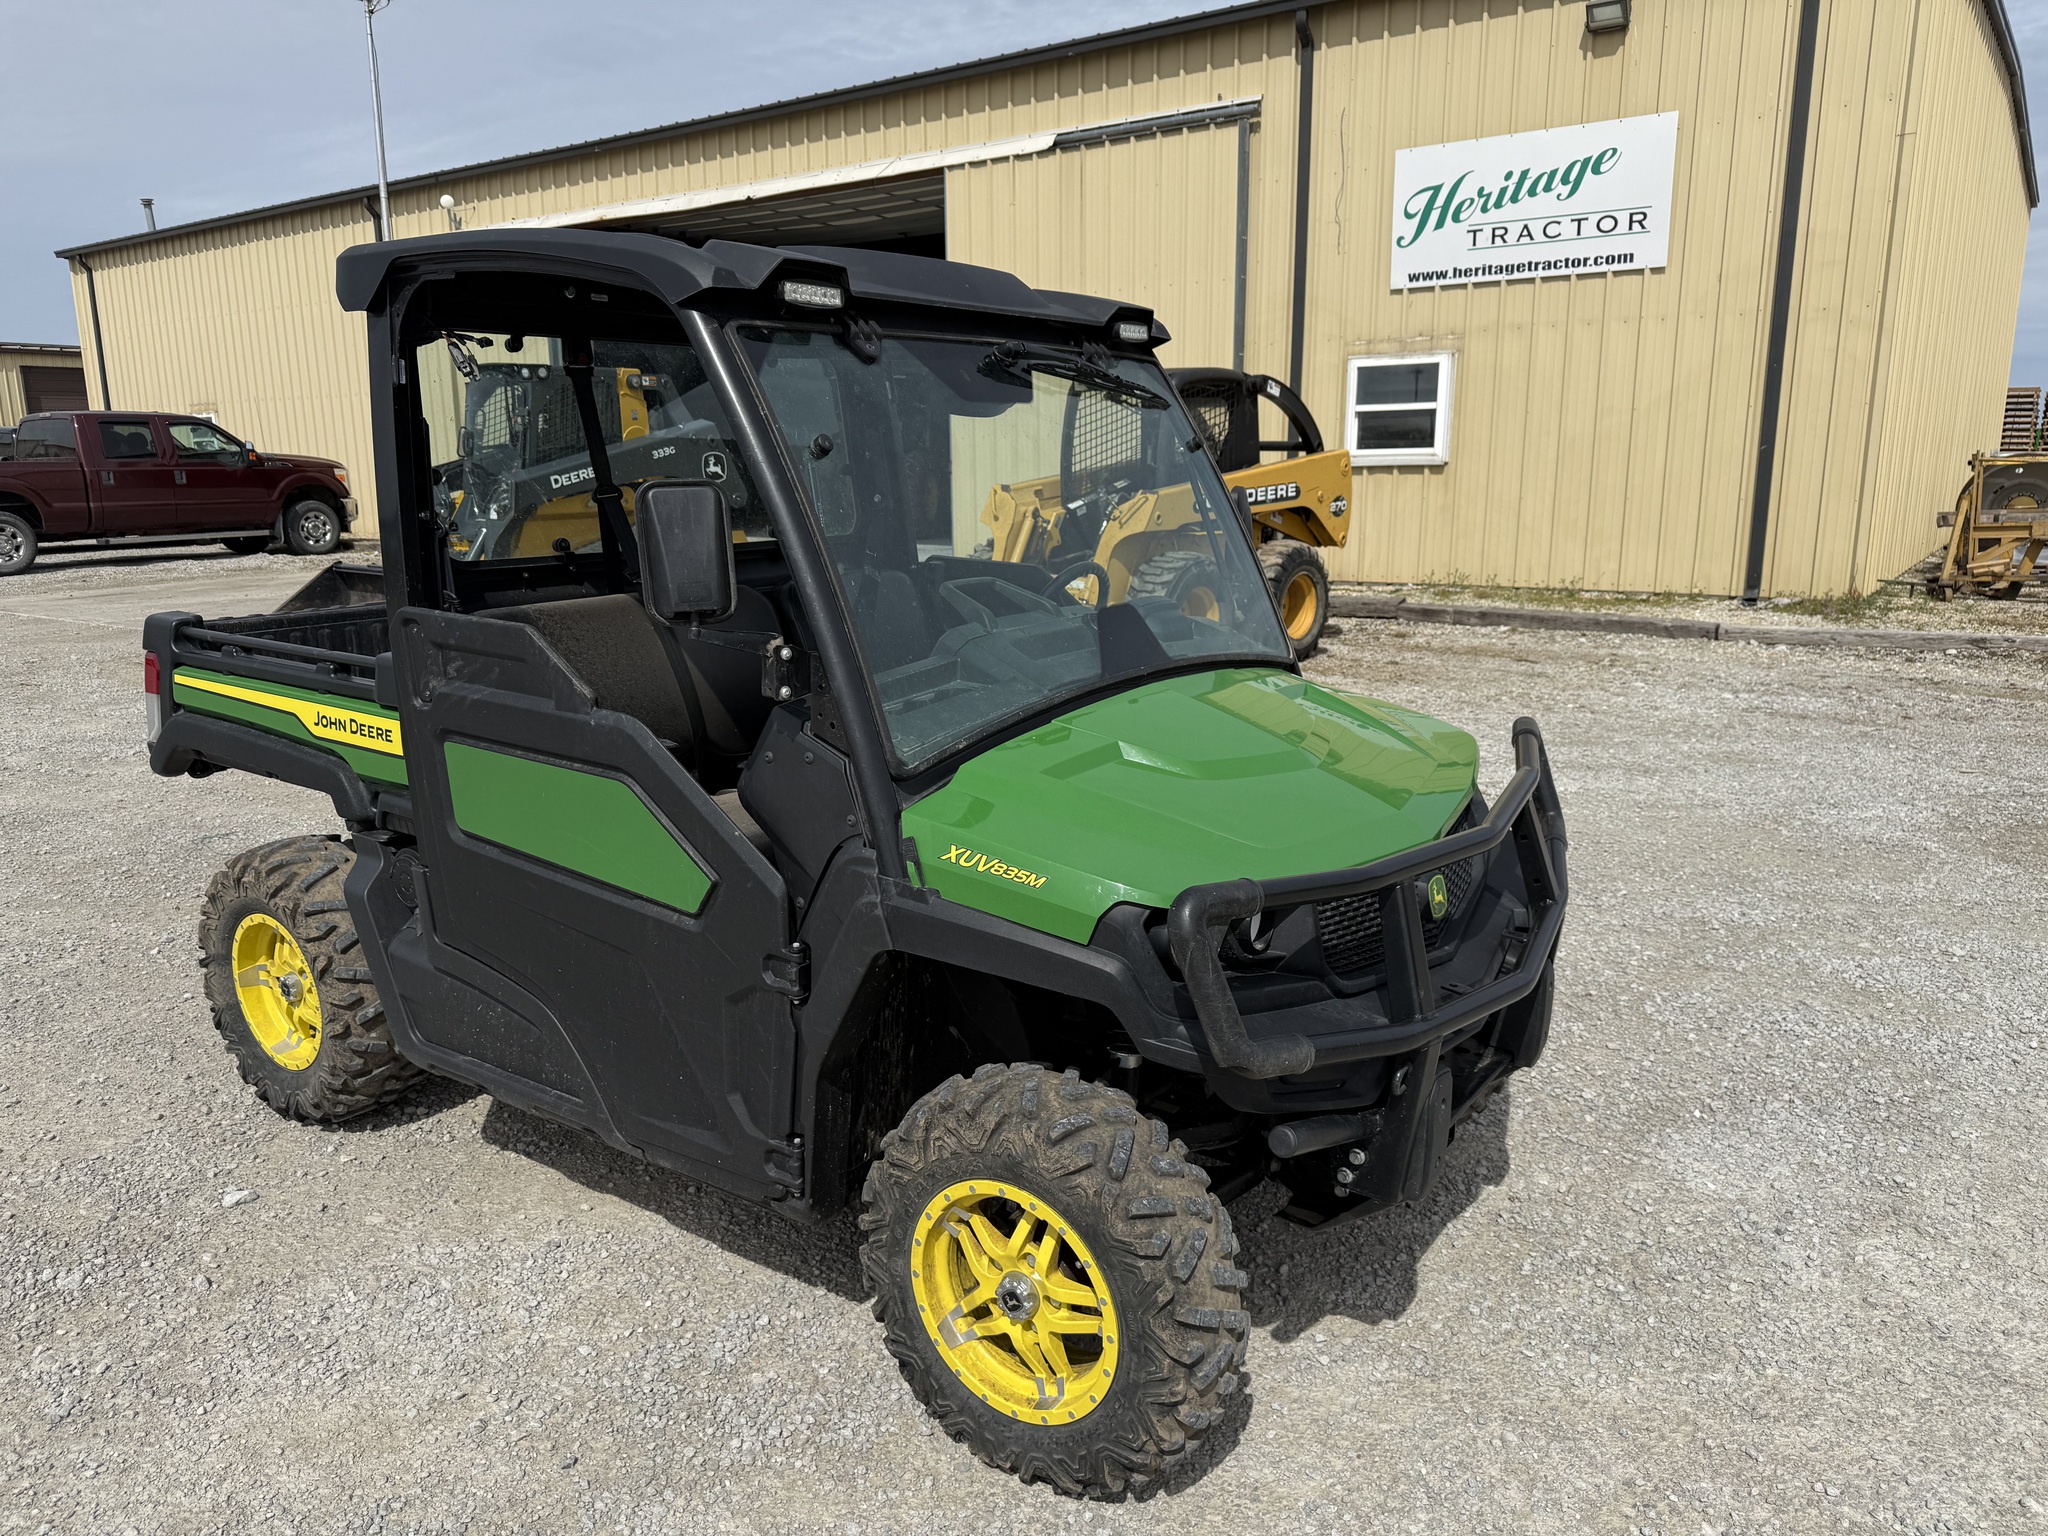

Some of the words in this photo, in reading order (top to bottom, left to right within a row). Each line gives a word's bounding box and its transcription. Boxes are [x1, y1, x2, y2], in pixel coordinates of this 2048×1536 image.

[1396, 146, 1623, 249] Heritage
[1466, 211, 1649, 247] TRACTOR
[1407, 252, 1635, 283] www.heritagetractor.com
[652, 446, 676, 460] 333G
[549, 467, 595, 489] DEERE
[1246, 483, 1297, 502] DEERE
[1329, 500, 1348, 512] 270
[313, 711, 347, 732] JOHN
[349, 718, 393, 743] DEERE
[938, 843, 1049, 890] XUV835M
